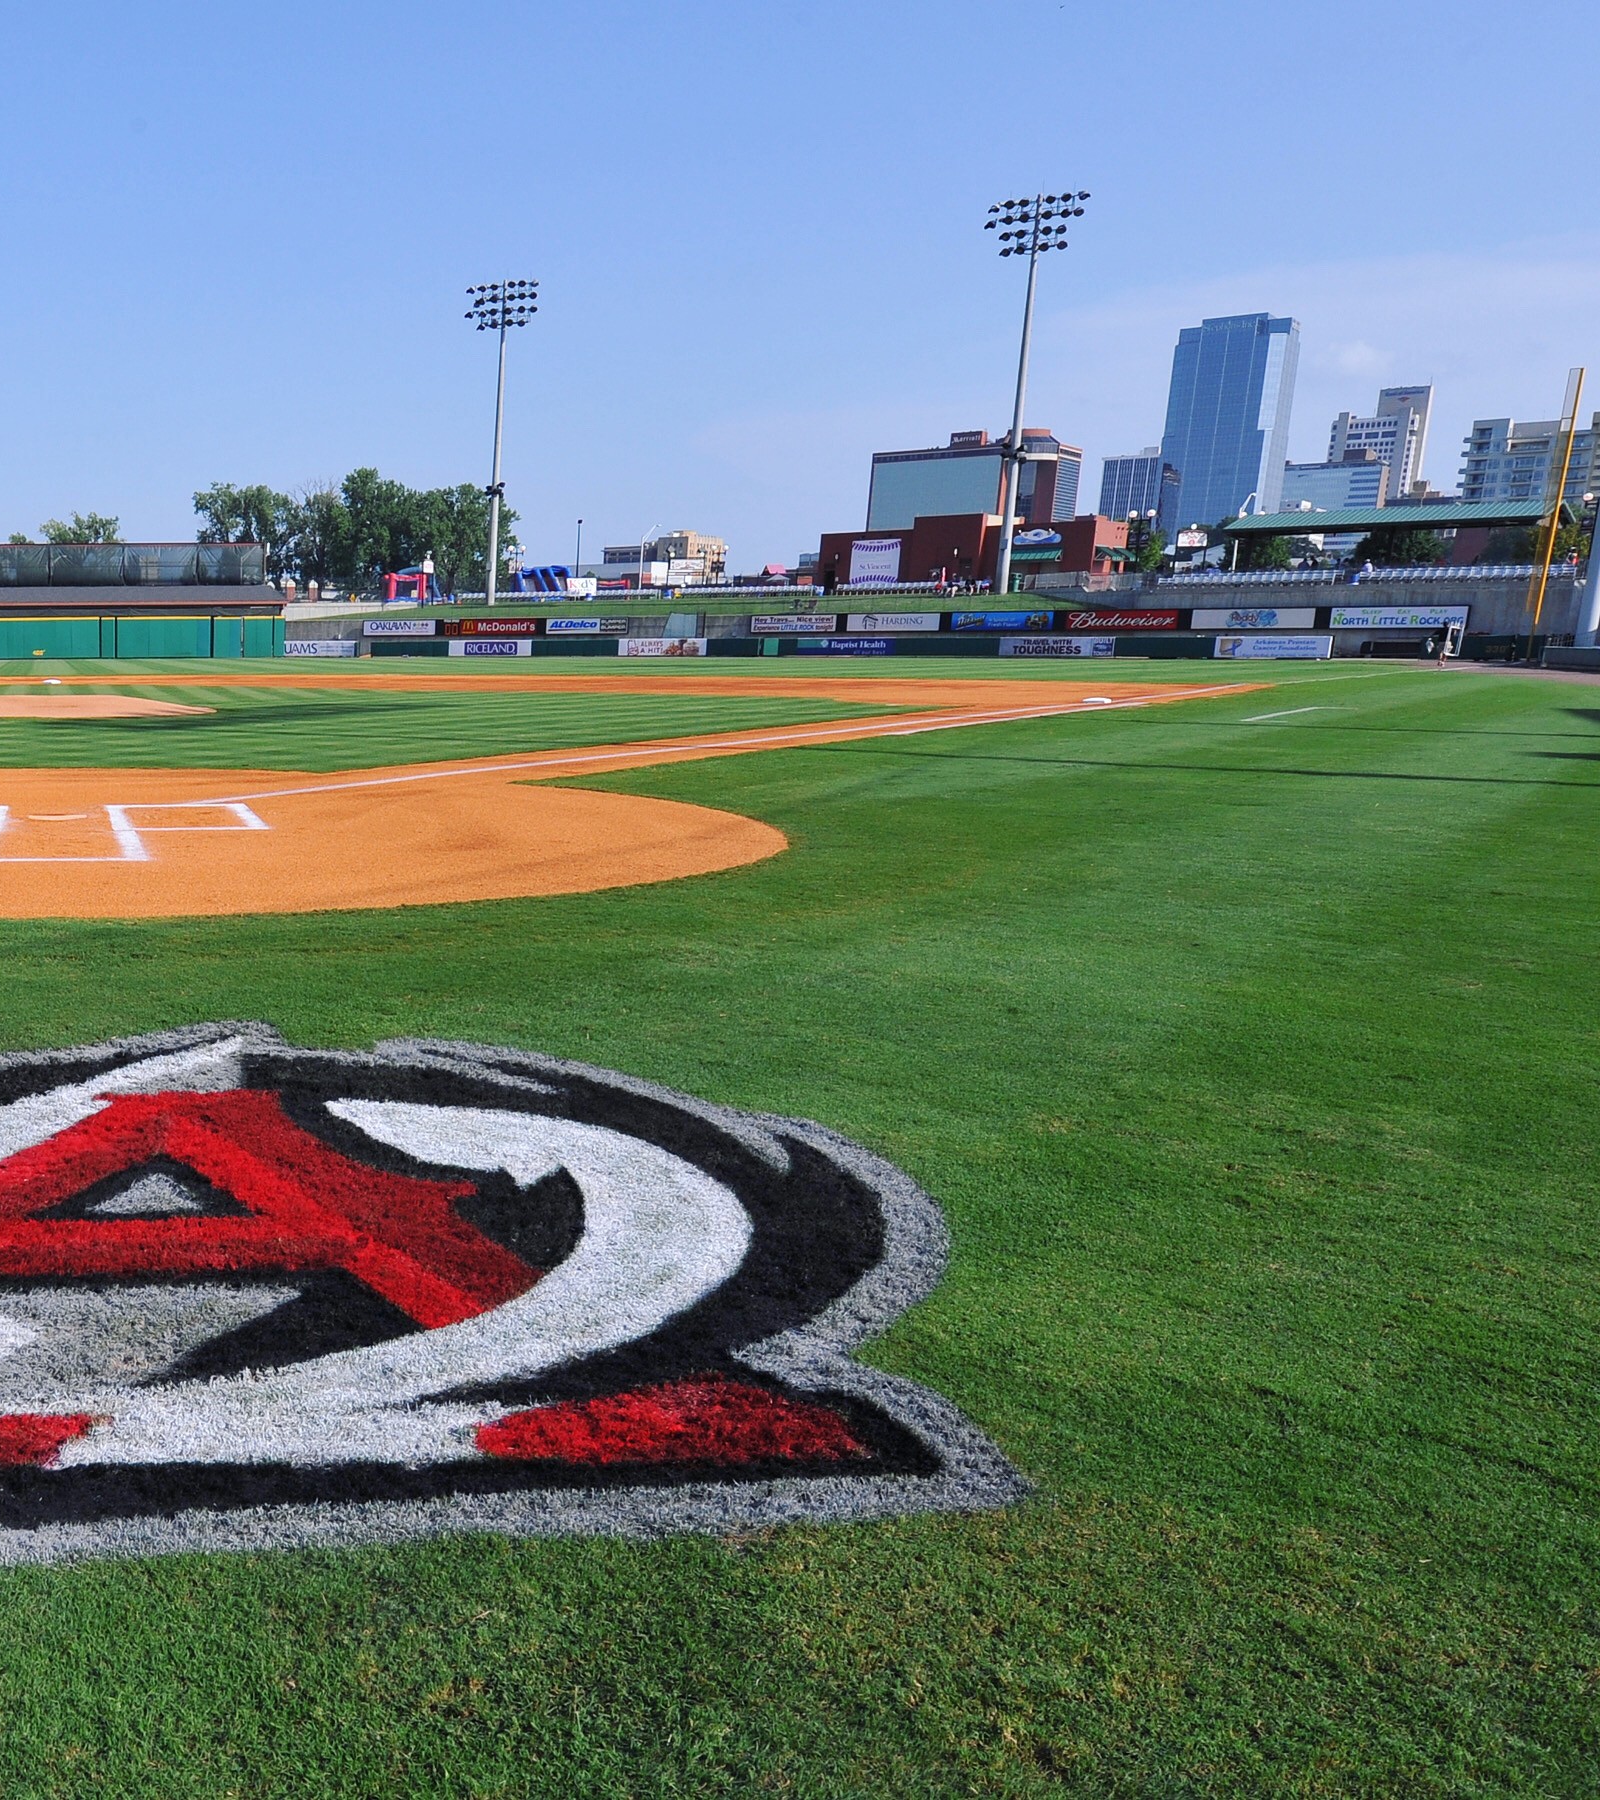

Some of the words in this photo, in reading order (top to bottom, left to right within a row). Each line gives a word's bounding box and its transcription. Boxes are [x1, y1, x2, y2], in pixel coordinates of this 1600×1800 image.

[952, 434, 980, 443] Marriott
[881, 616, 923, 625] HARDING
[1069, 612, 1174, 629] Budweiser
[1333, 613, 1368, 625] NORTH
[1373, 615, 1406, 624] LITTLE
[370, 622, 411, 630] OAKLAWN
[478, 622, 535, 631] McDonald's
[466, 644, 514, 654] RICELAND
[831, 641, 857, 649] Baptist
[1013, 646, 1081, 654] TOUGHNESS
